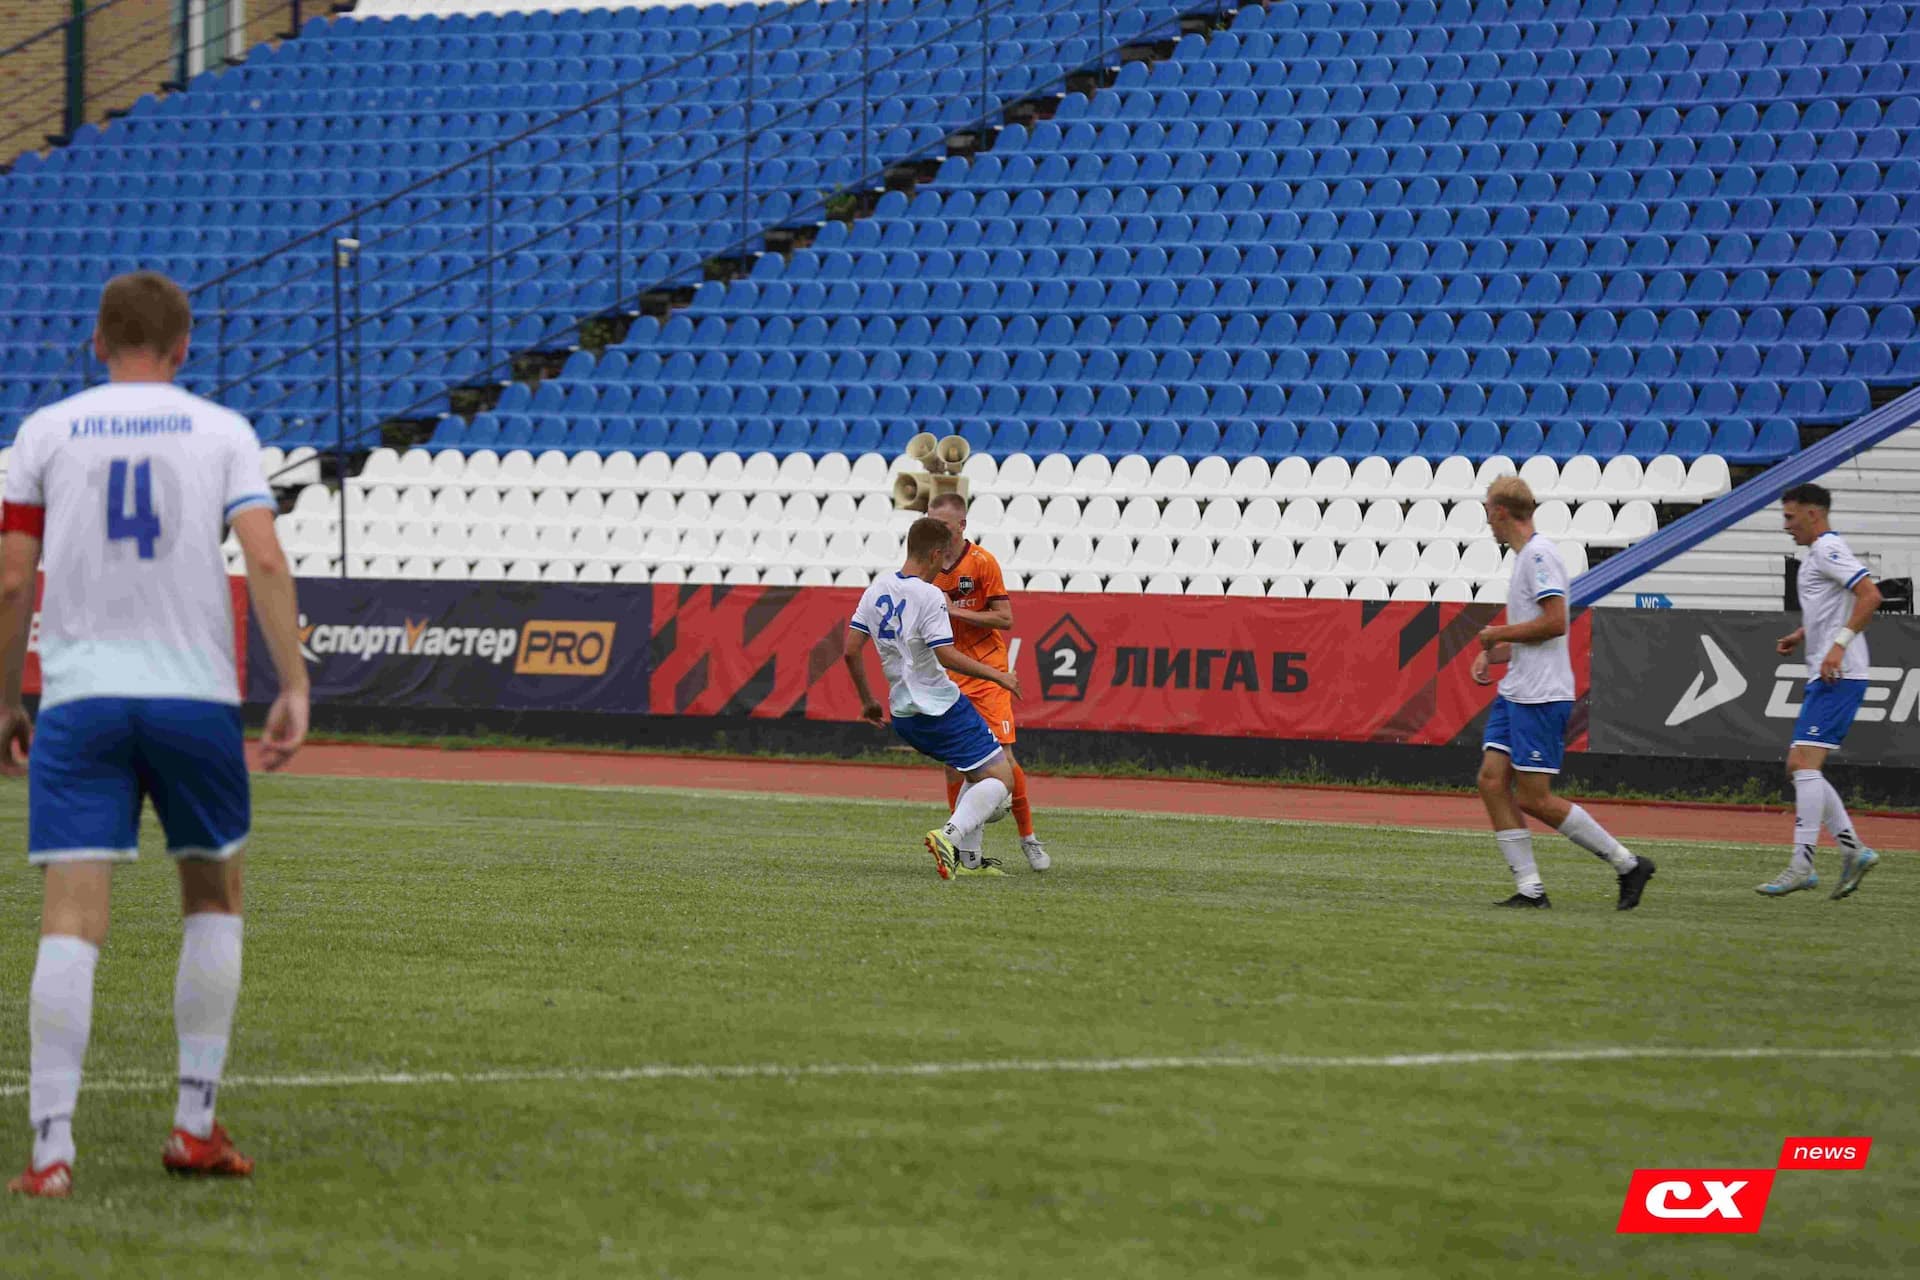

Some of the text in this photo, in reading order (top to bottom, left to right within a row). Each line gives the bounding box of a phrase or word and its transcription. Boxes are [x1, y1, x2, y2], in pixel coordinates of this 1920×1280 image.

[107, 458, 162, 560] 4
[875, 593, 907, 640] 21
[1640, 596, 1660, 609] WC
[523, 629, 605, 666] PRO
[1052, 648, 1078, 677] 2
[1110, 645, 1309, 693] ЛИГА Б
